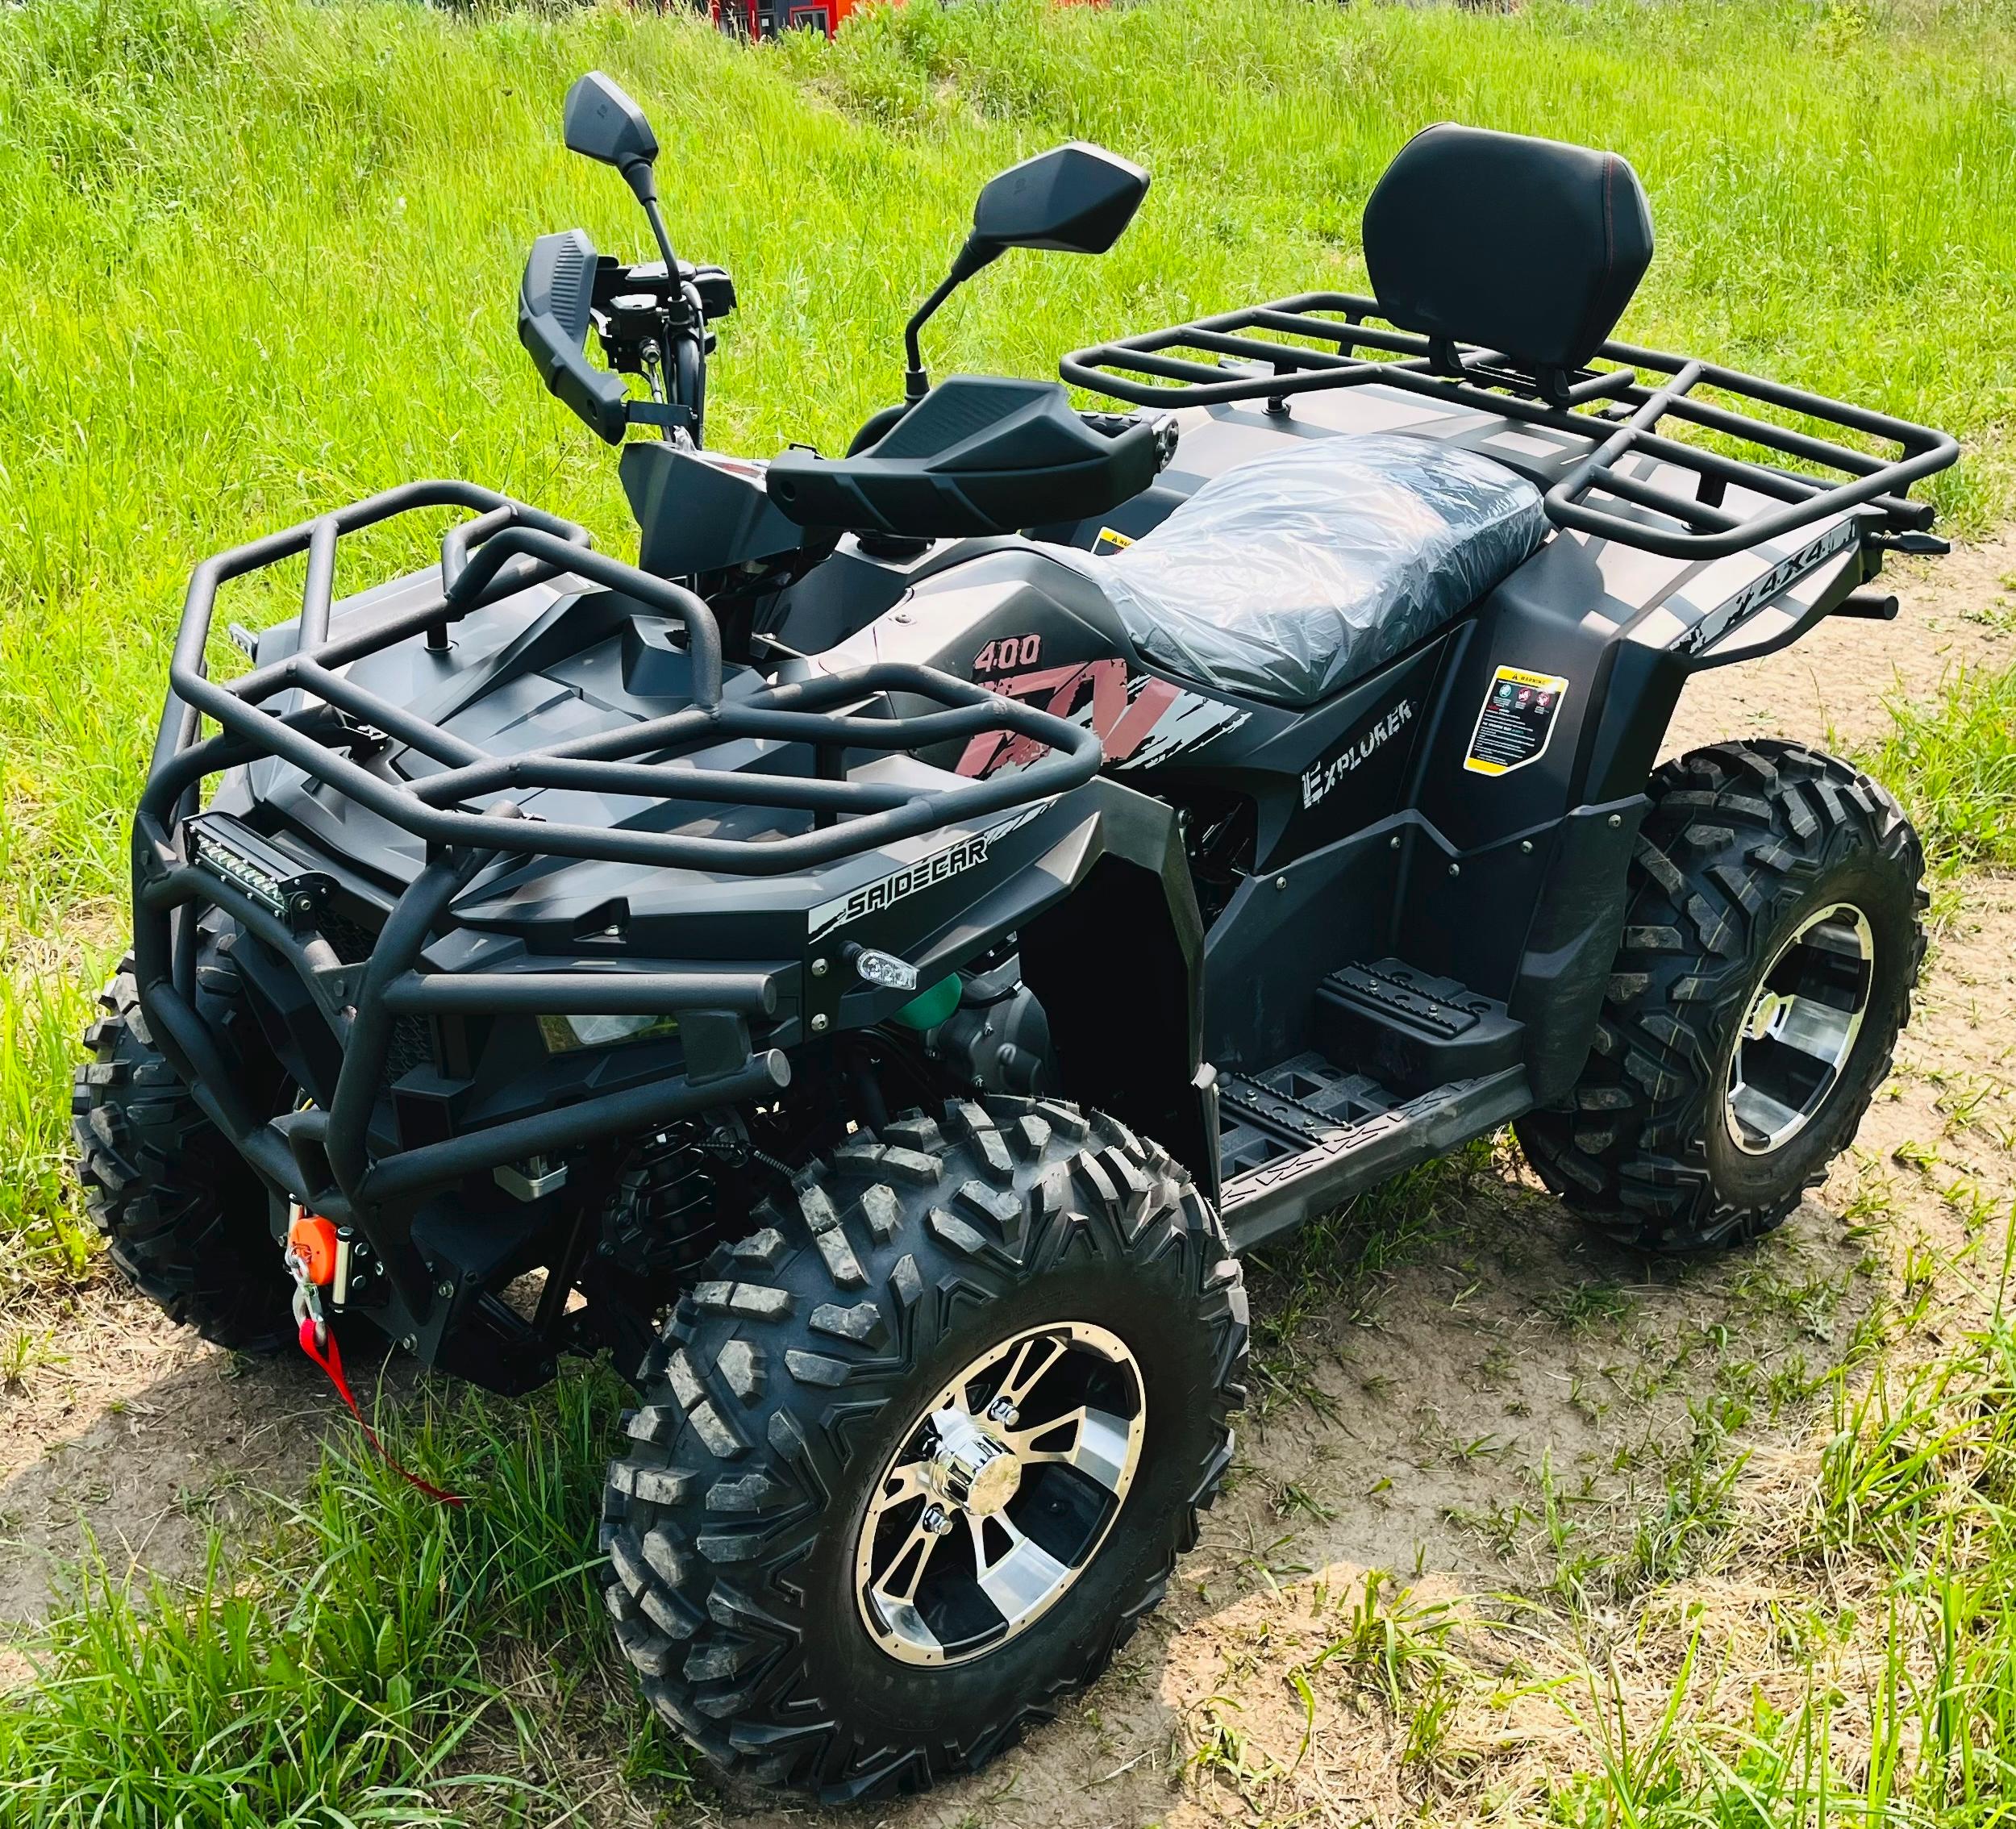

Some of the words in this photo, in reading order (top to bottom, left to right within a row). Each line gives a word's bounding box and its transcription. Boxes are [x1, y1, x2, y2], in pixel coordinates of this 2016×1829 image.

[974, 633, 1042, 673] 400
[1302, 699, 1413, 810] EXPLORER
[846, 837, 989, 919] SAIDECAR
